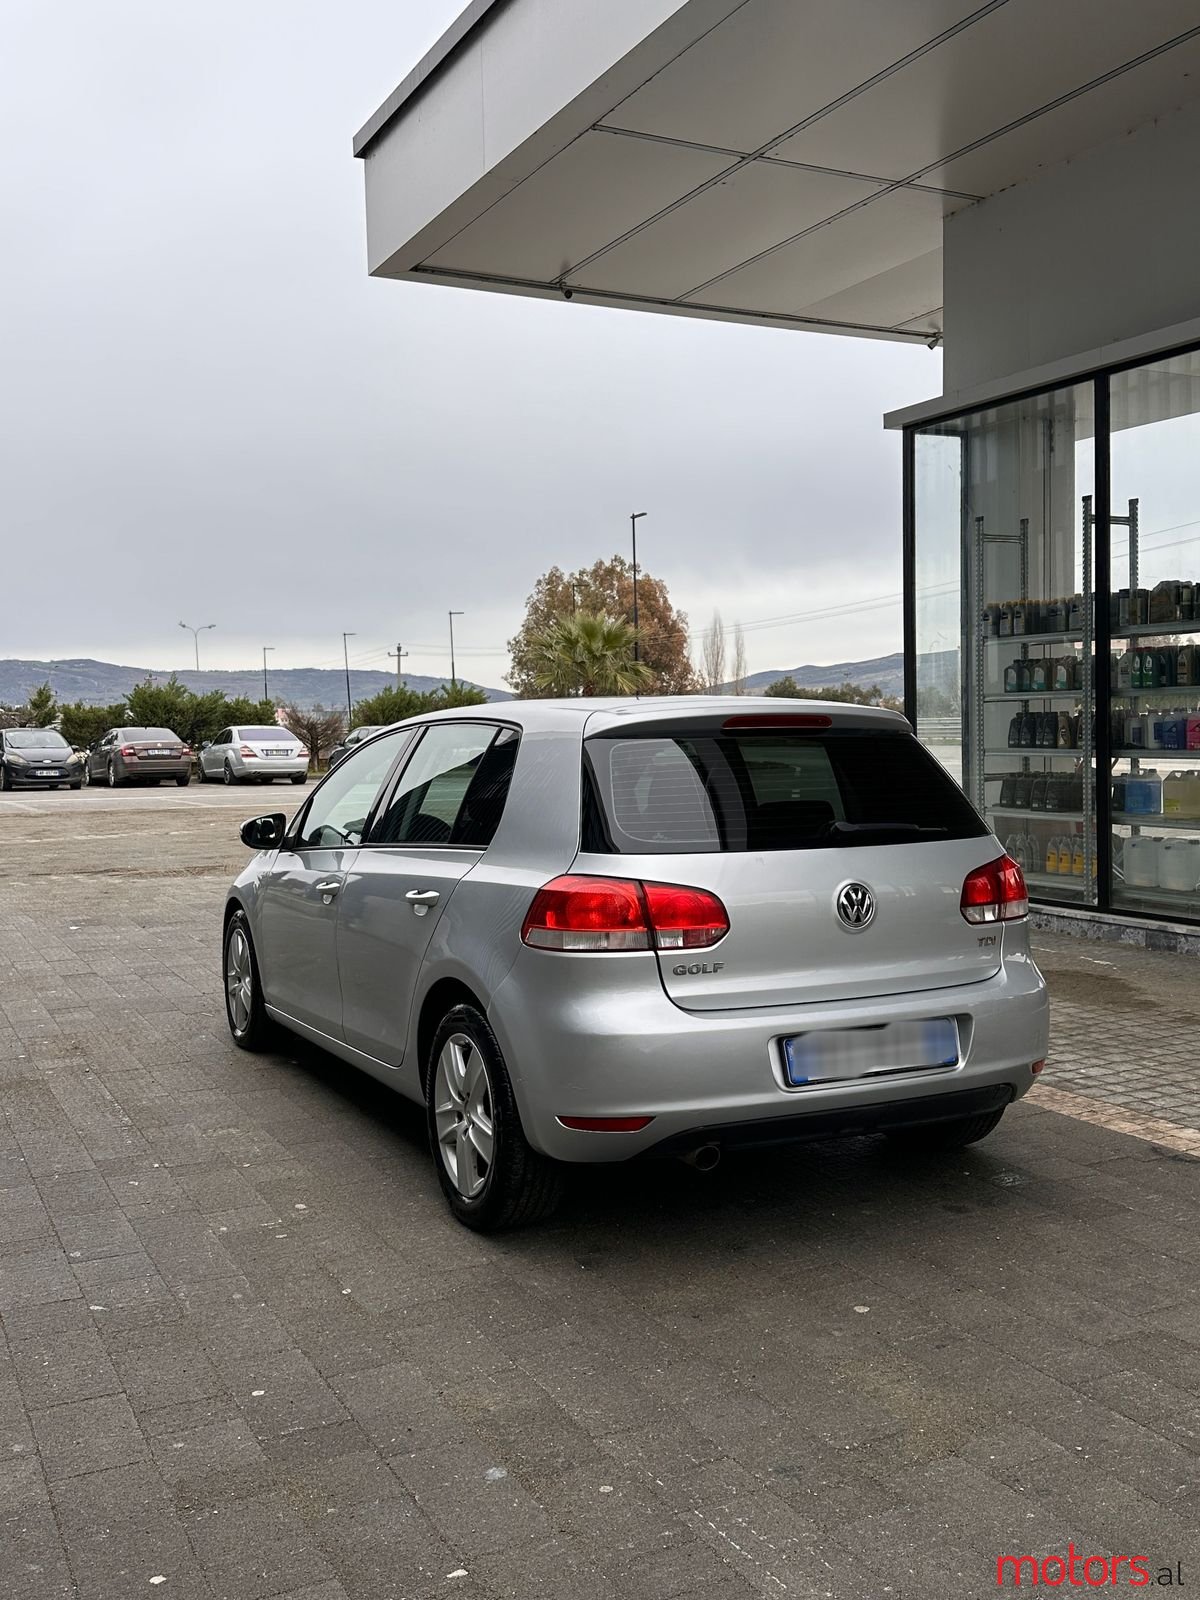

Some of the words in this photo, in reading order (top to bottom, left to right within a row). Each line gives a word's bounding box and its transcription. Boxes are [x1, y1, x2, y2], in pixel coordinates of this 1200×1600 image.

[838, 883, 874, 928] VW
[976, 935, 996, 947] TDI
[672, 962, 724, 976] GOLF
